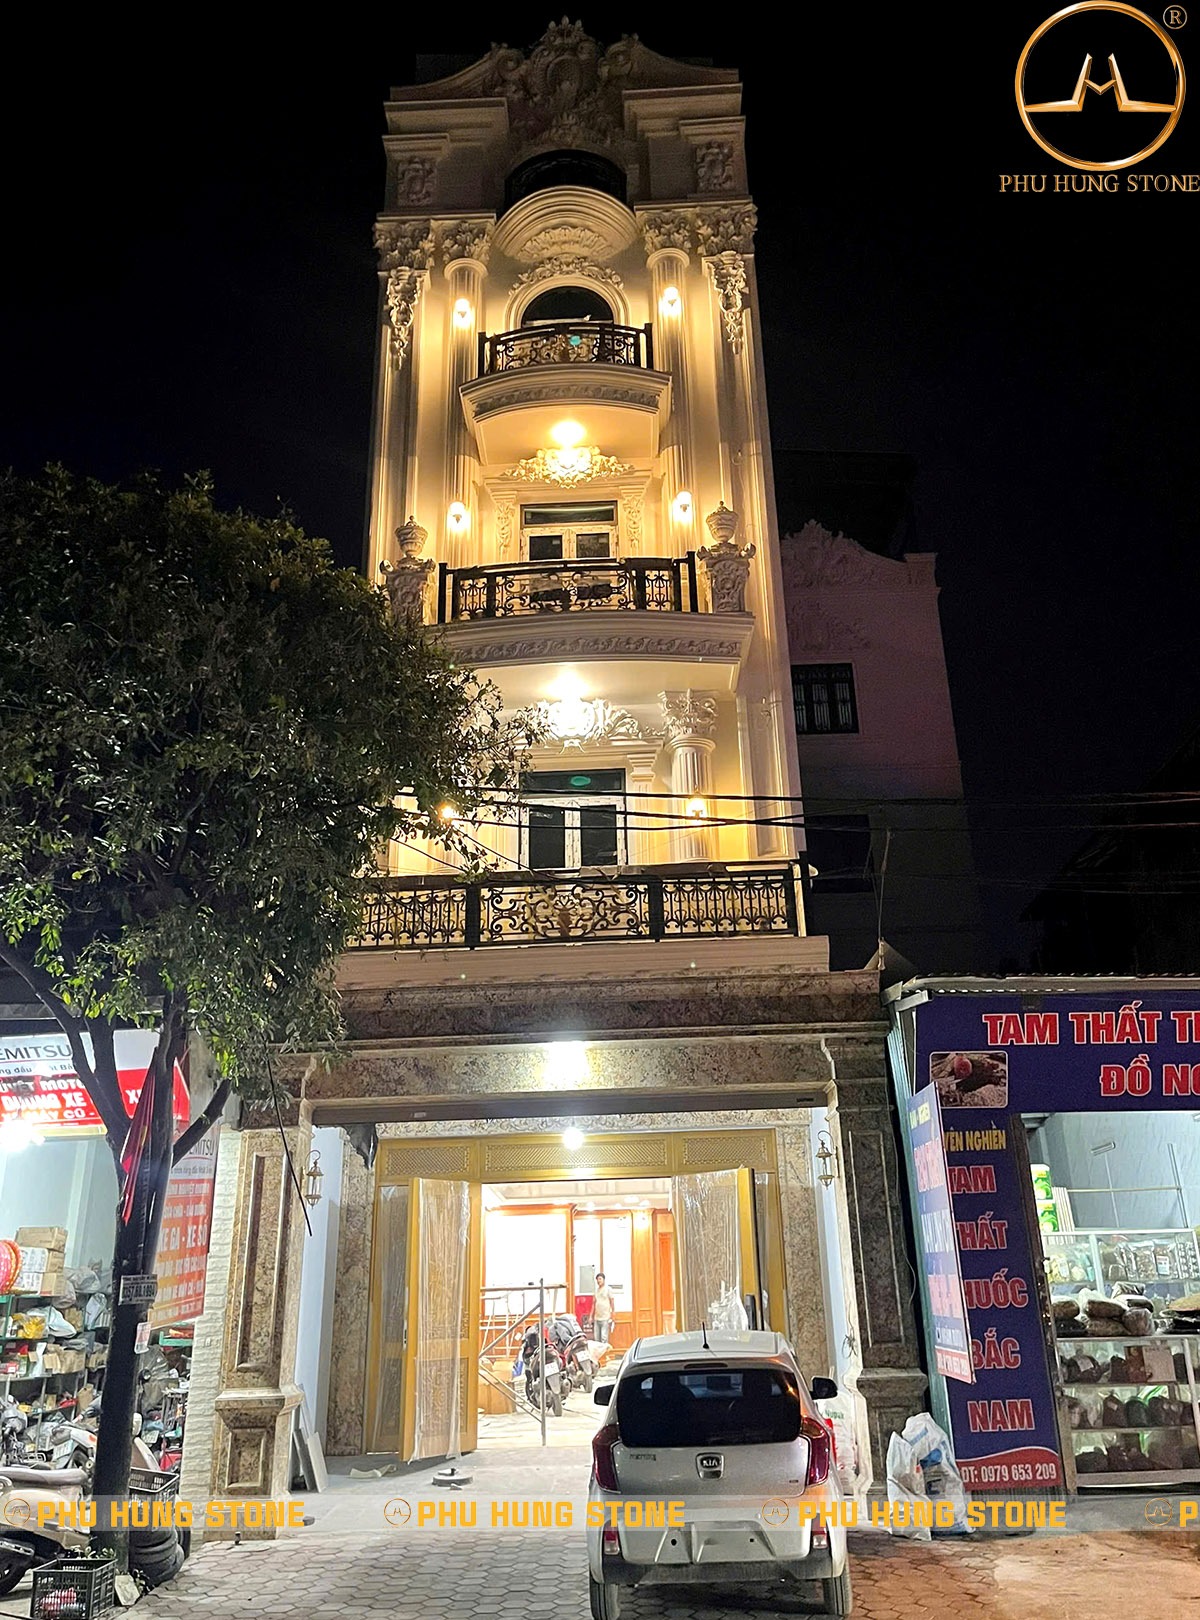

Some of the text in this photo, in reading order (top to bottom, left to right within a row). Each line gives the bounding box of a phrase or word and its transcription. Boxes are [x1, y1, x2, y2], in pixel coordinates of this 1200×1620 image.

[982, 1013, 1059, 1045] TAM
[1069, 1001, 1162, 1044] THẤT
[1100, 1054, 1152, 1096] ĐỒ
[61, 1091, 87, 1107] XE
[965, 1119, 1006, 1151] NGHIỀN
[956, 1211, 1008, 1250] HẤT
[967, 1399, 1035, 1432] NAM
[981, 1465, 1009, 1482] 0979
[1011, 1463, 1032, 1480] 653
[1035, 1462, 1057, 1479] 209
